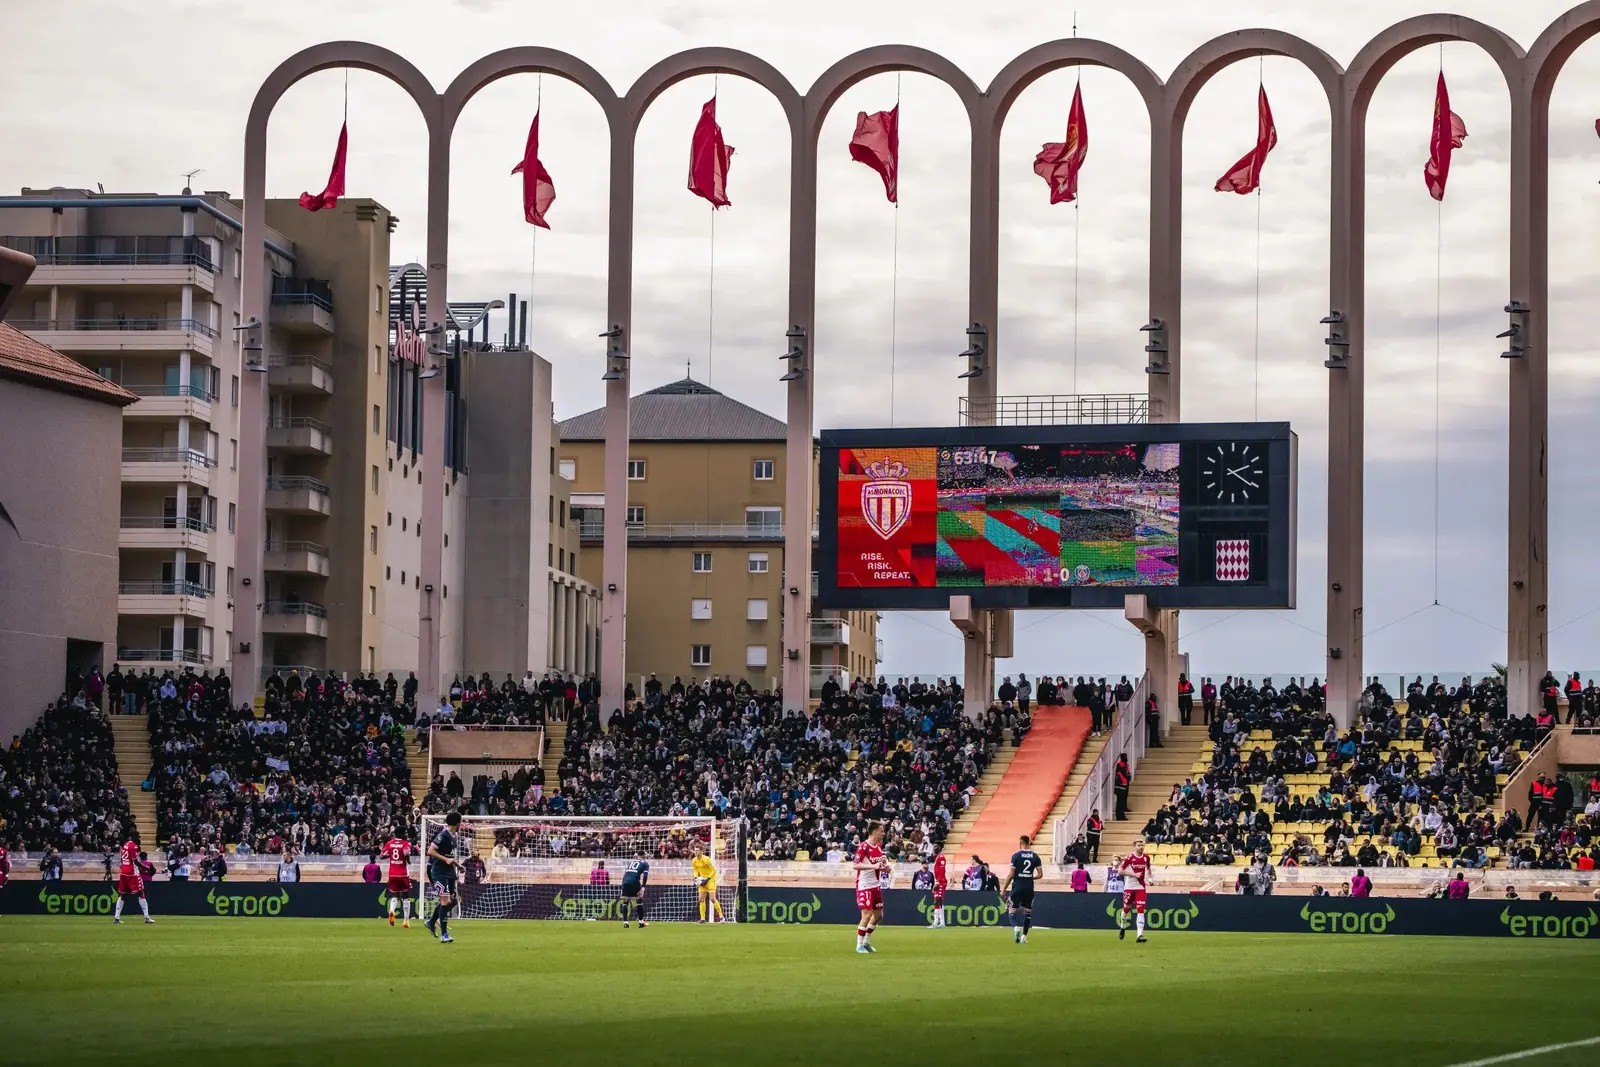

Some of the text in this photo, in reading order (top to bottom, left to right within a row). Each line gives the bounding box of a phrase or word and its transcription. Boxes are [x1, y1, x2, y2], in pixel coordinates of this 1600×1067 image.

[954, 450, 998, 465] 63:47
[860, 552, 884, 560] RISE.
[867, 562, 892, 570] RISK.
[873, 571, 911, 579] REPEAT.
[392, 848, 400, 860] 8
[628, 861, 640, 870] 10
[1022, 859, 1032, 874] 2
